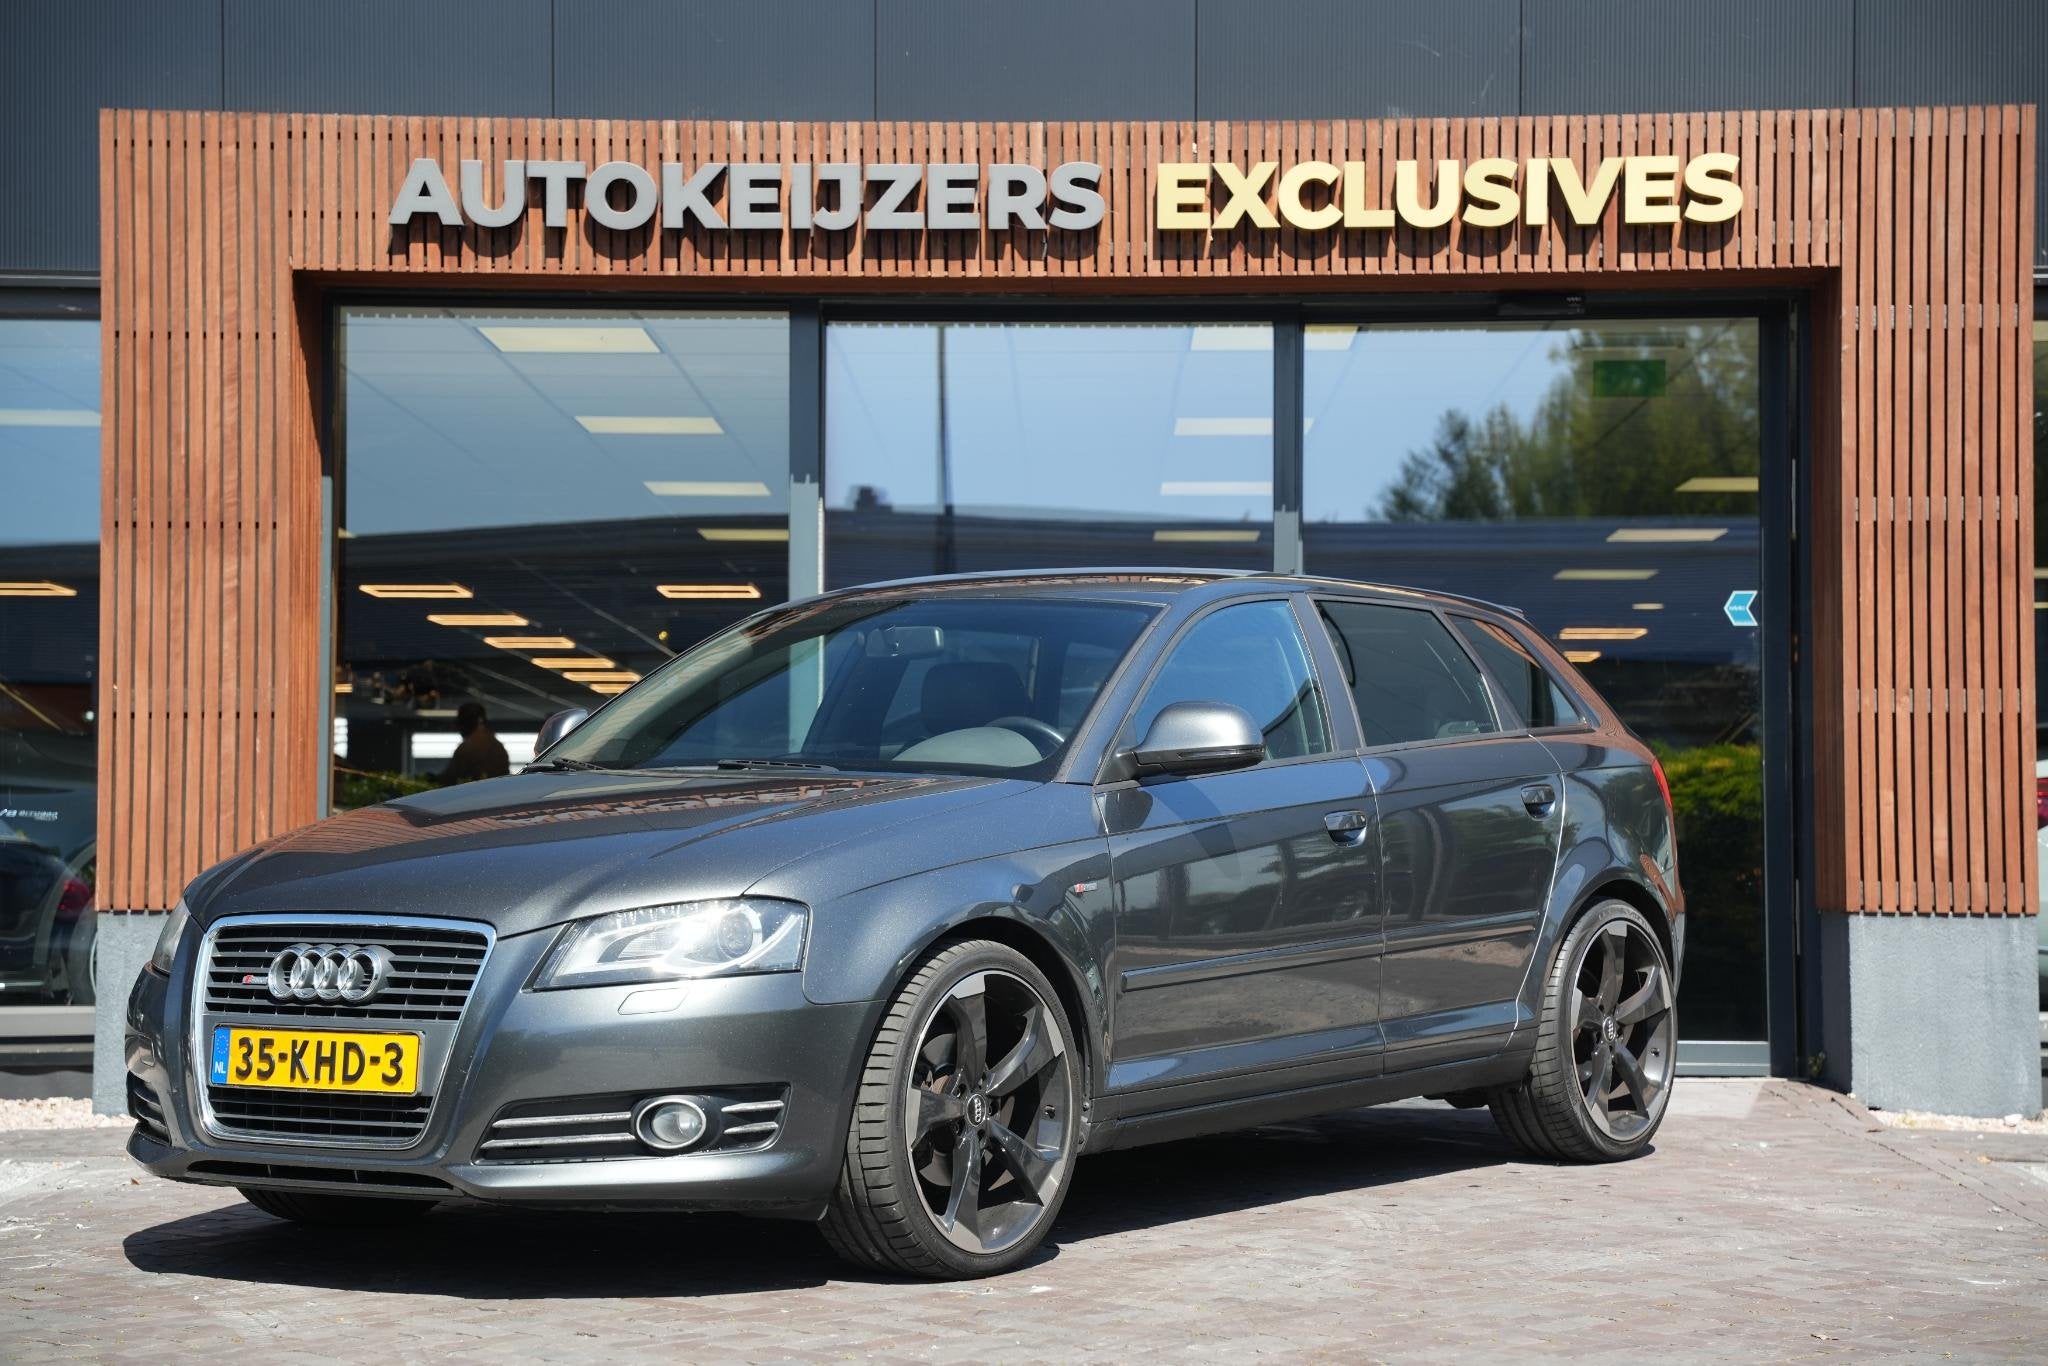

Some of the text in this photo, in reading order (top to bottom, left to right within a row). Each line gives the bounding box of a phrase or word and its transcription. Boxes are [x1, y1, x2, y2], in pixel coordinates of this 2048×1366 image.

[389, 152, 1743, 230] AUTOKEIJZERS EXCLUSIVES
[214, 1061, 226, 1074] NL
[235, 1036, 404, 1085] 35-KHD-3
